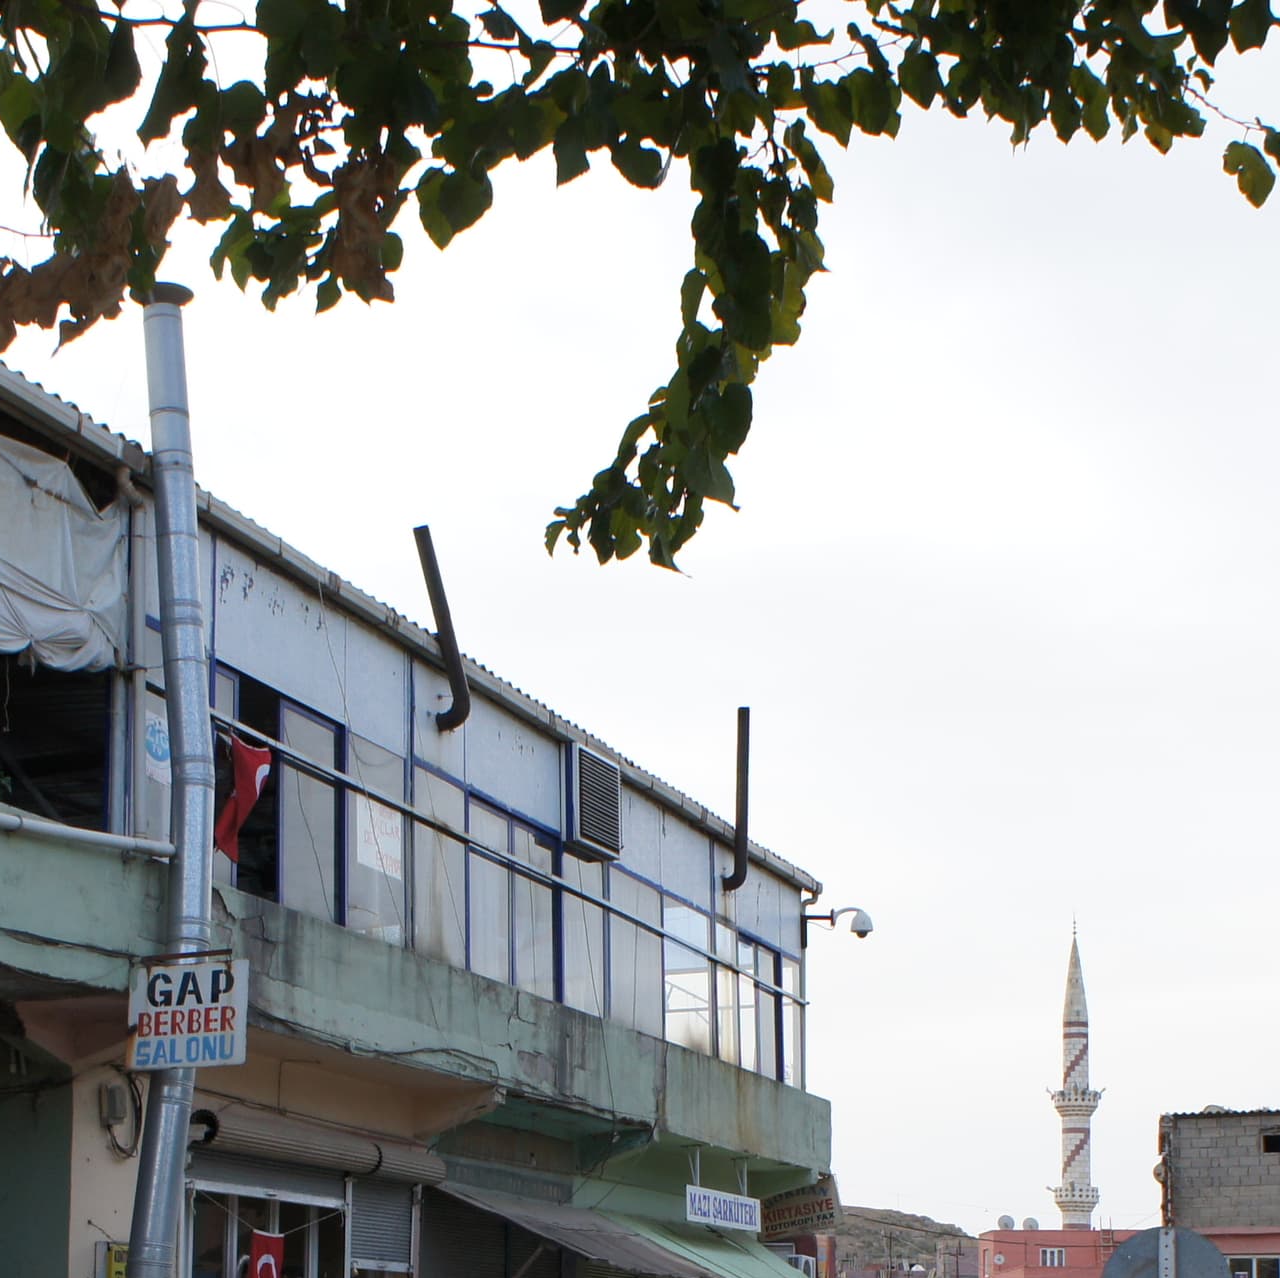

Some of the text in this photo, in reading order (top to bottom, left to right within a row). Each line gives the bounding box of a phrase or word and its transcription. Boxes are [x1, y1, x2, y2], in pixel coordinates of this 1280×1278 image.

[147, 969, 234, 1007] GAP
[137, 1006, 236, 1037] BERBER
[136, 1034, 234, 1066] SALONU
